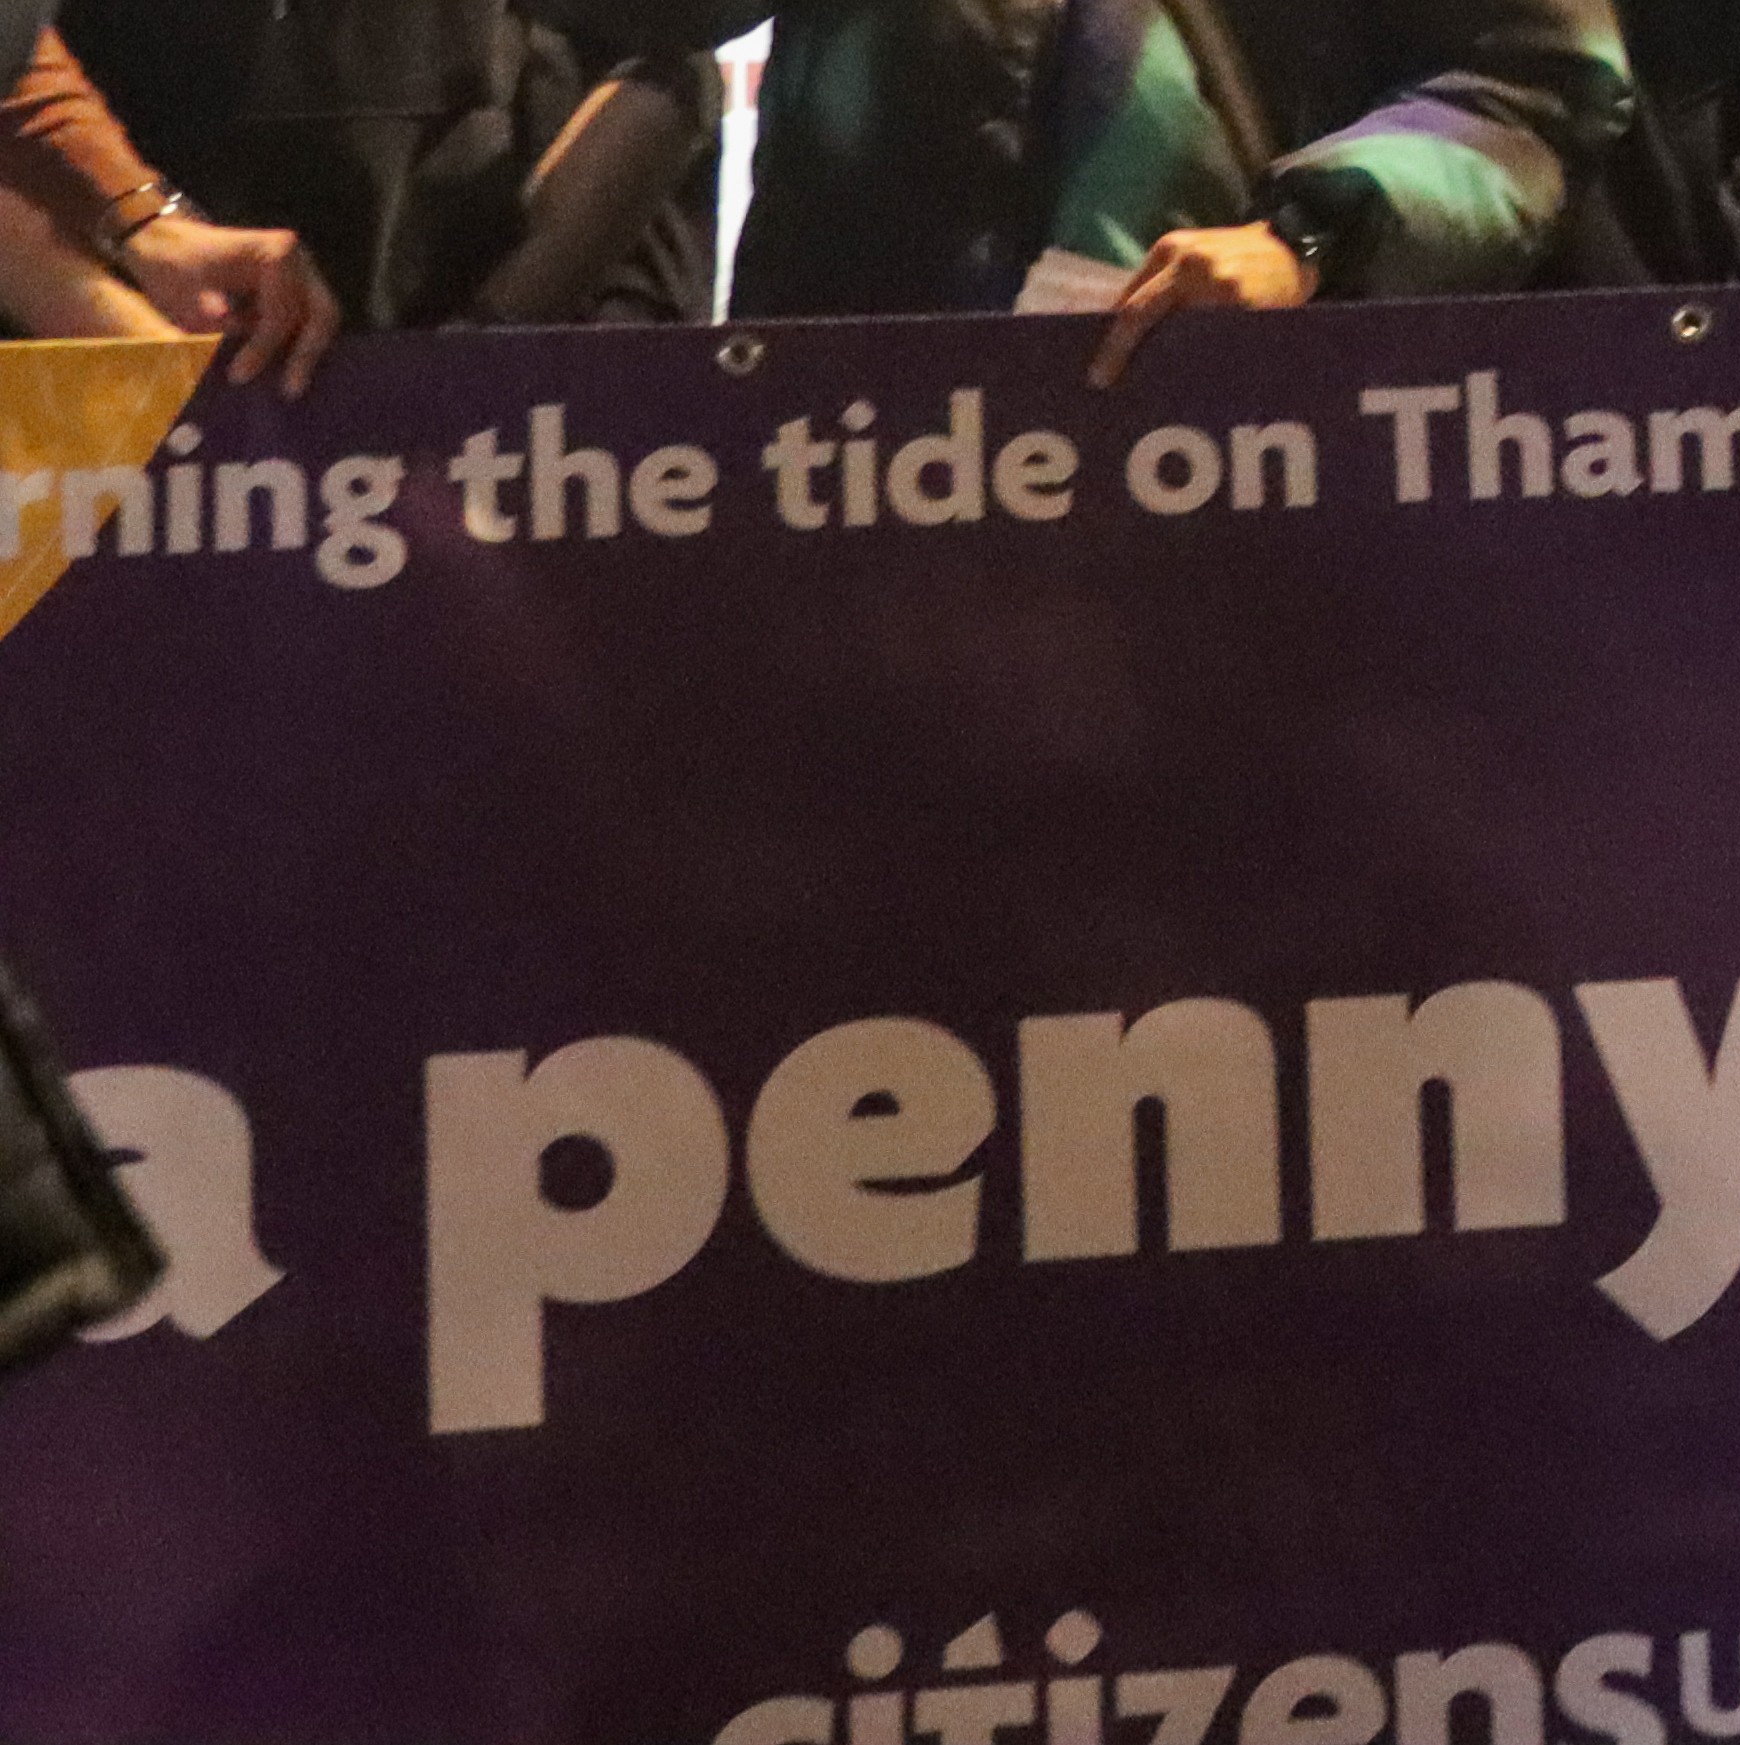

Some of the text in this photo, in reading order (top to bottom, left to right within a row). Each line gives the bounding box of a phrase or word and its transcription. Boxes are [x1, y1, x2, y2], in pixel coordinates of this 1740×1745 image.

[449, 404, 719, 546] the
[762, 387, 1079, 533] tide
[1125, 417, 1319, 521] on
